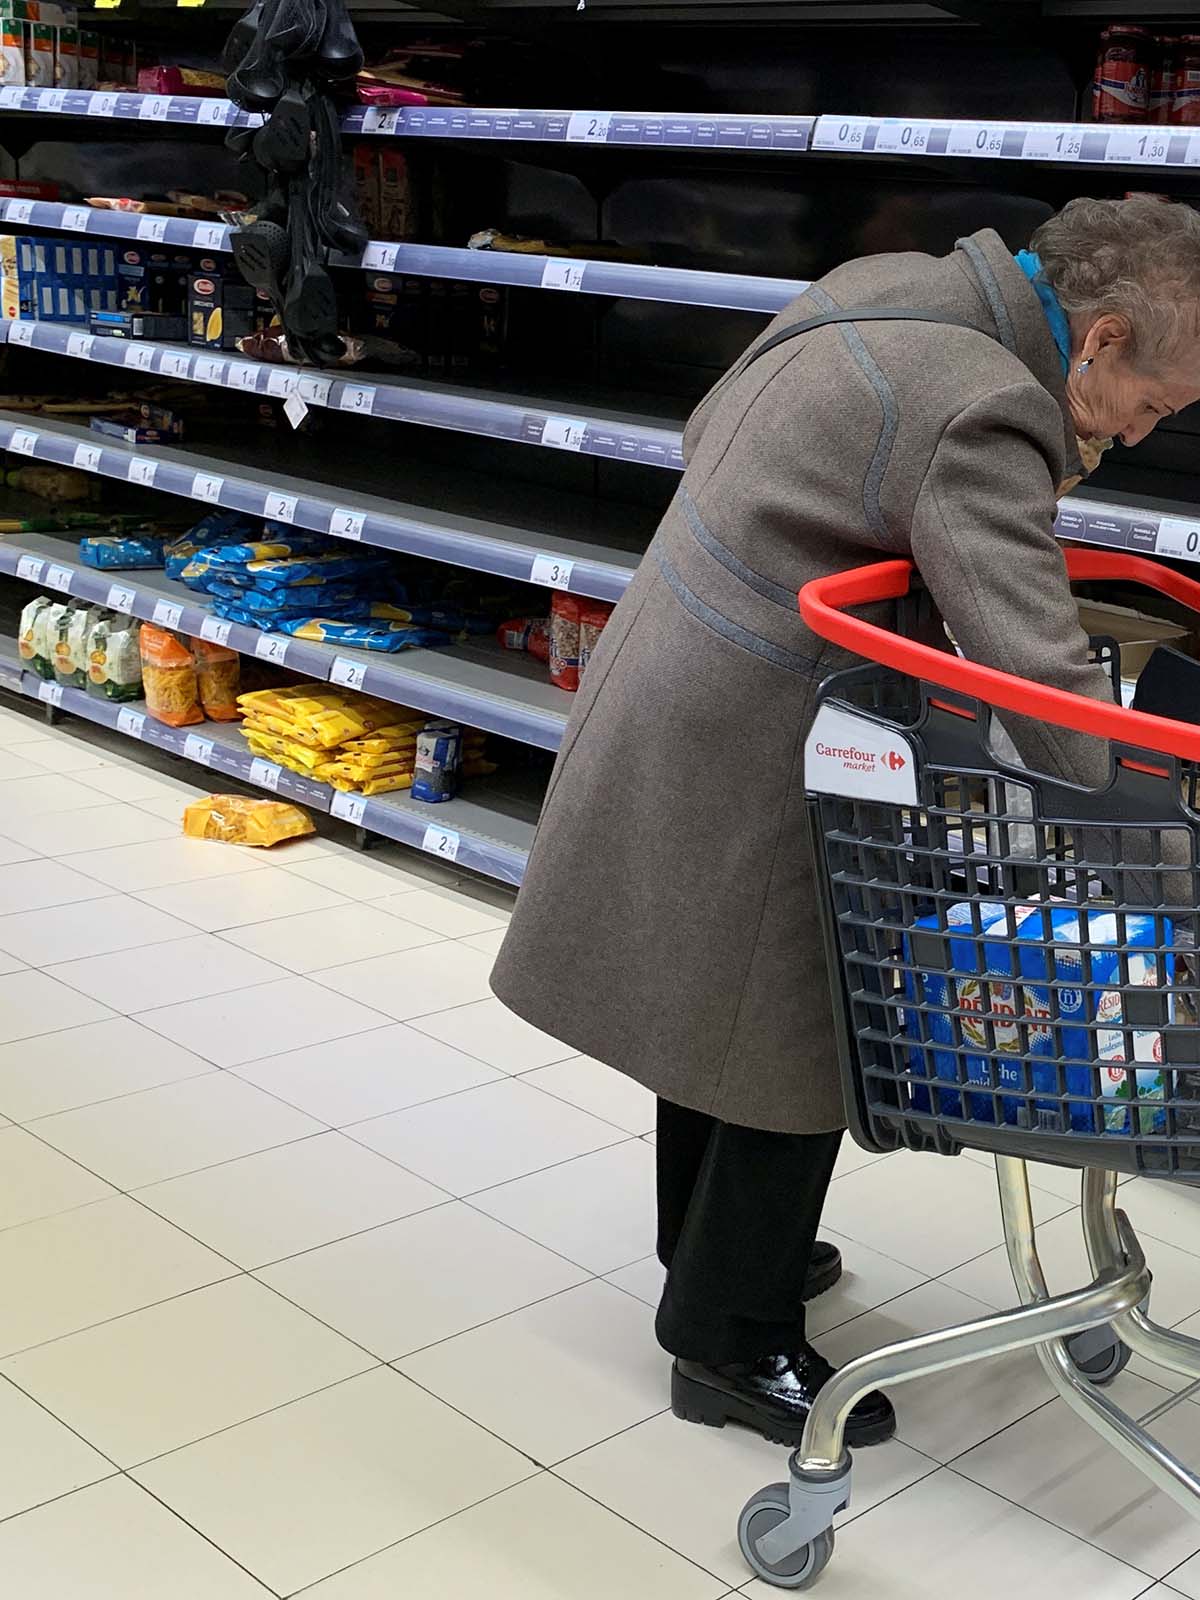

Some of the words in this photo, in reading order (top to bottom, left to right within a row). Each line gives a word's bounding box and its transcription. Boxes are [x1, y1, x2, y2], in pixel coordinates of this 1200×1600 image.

[839, 124, 861, 142] 0,65
[901, 127, 924, 146] 0,65
[976, 130, 1001, 150] 0,65
[1056, 132, 1080, 153] 1,25
[816, 742, 875, 762] Carrefour
[843, 761, 875, 773] market
